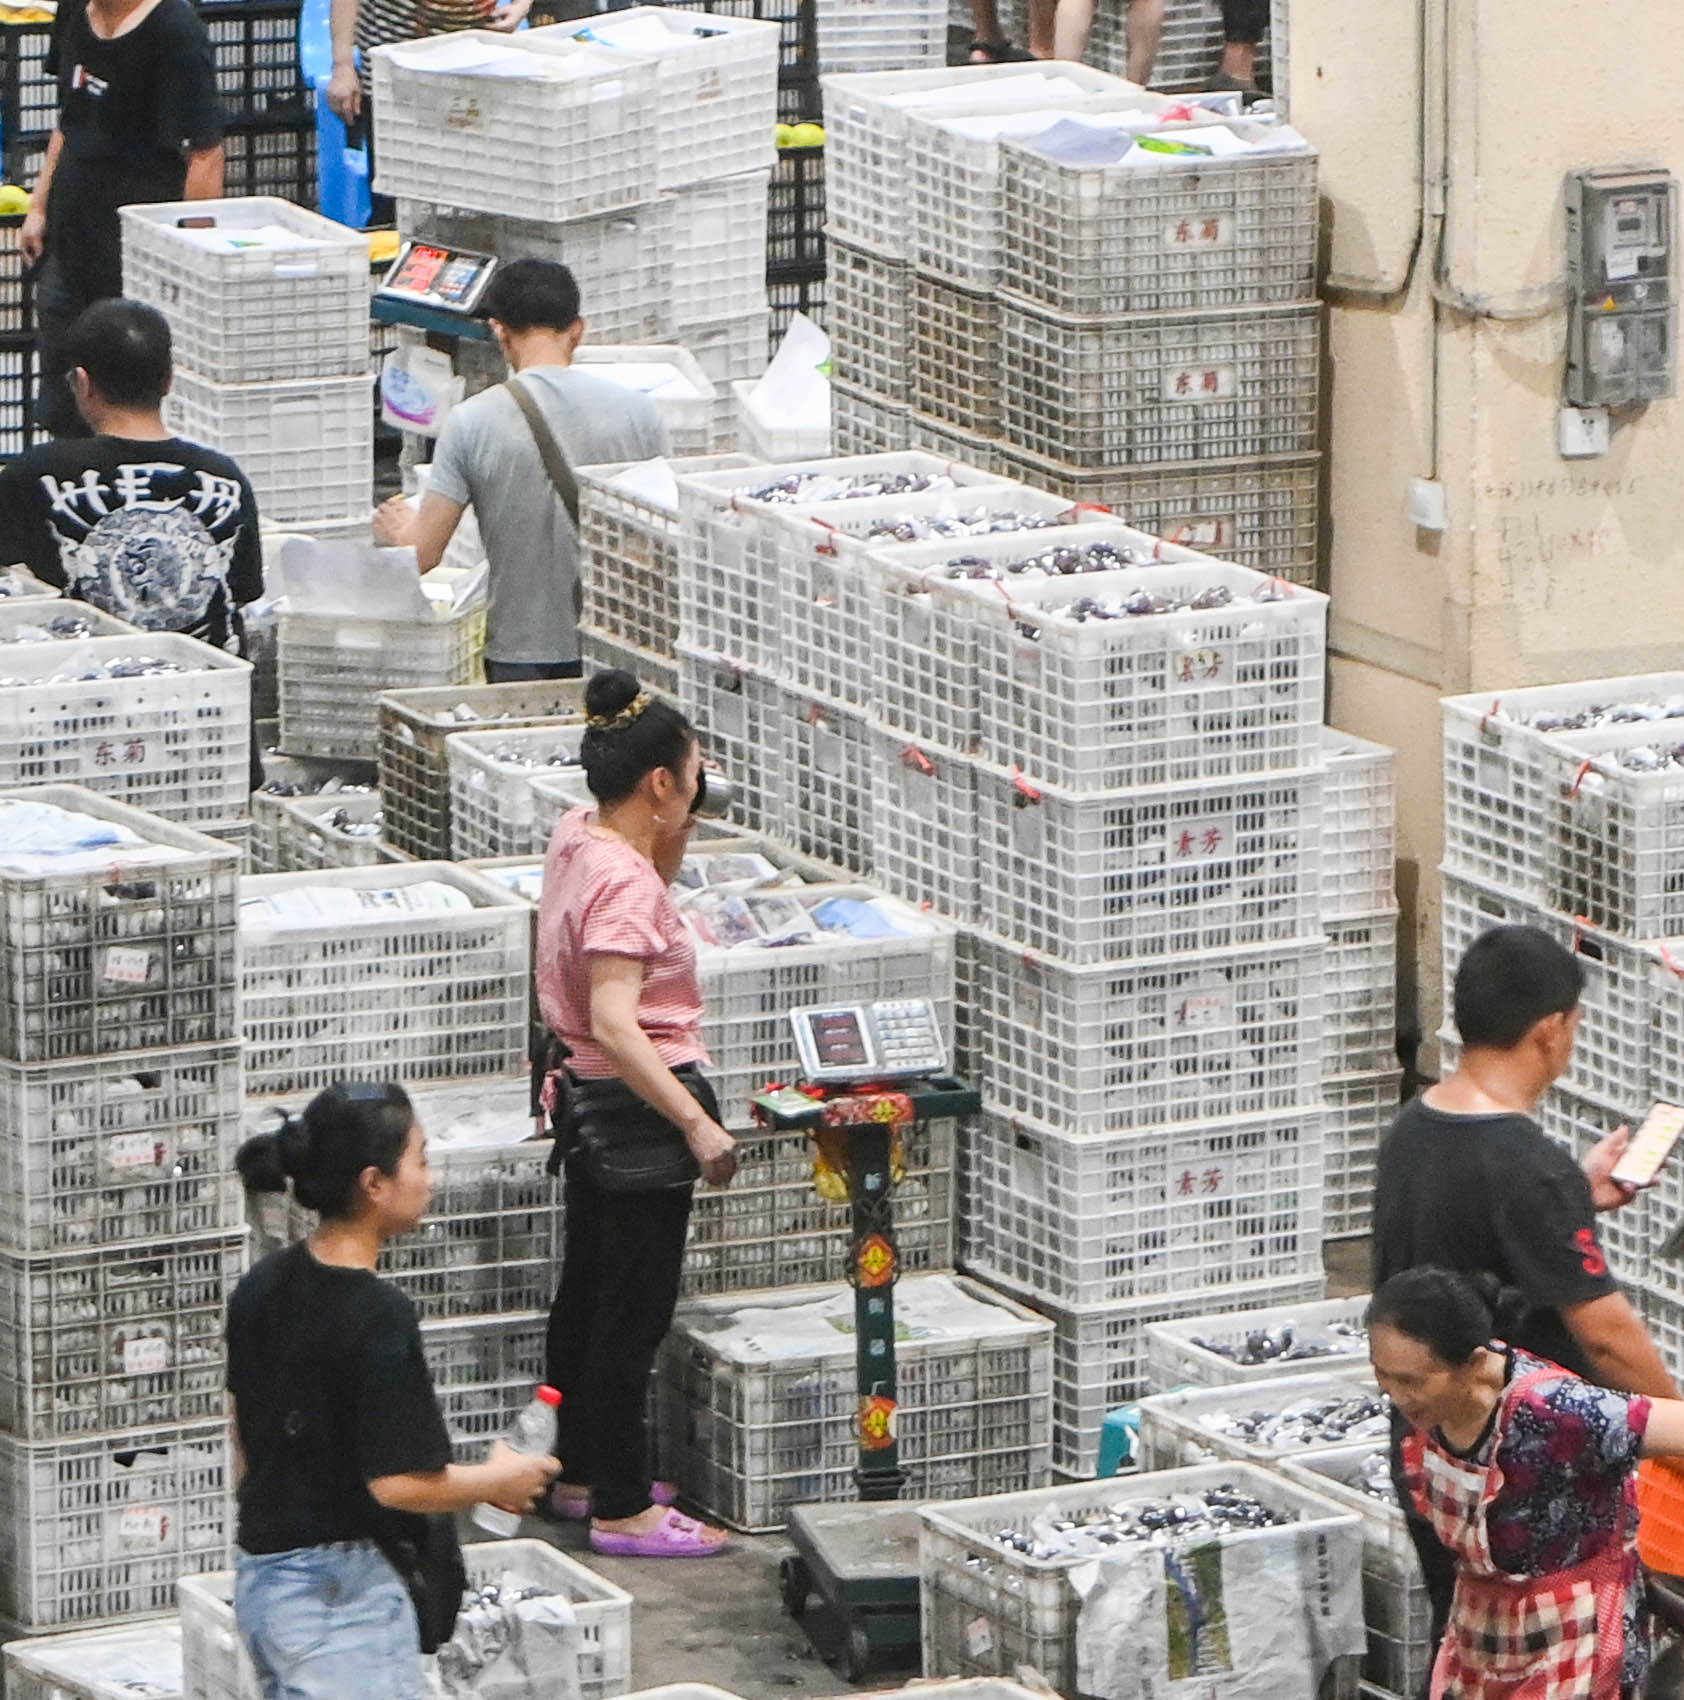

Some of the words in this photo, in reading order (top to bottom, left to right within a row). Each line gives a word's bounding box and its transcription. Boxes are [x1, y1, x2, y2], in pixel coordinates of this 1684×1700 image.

[1175, 217, 1220, 244] 东菊
[1175, 369, 1220, 396] 东菊
[96, 738, 147, 766] 东菊
[1178, 826, 1220, 858] 素芳
[1179, 1167, 1222, 1197] 素芳
